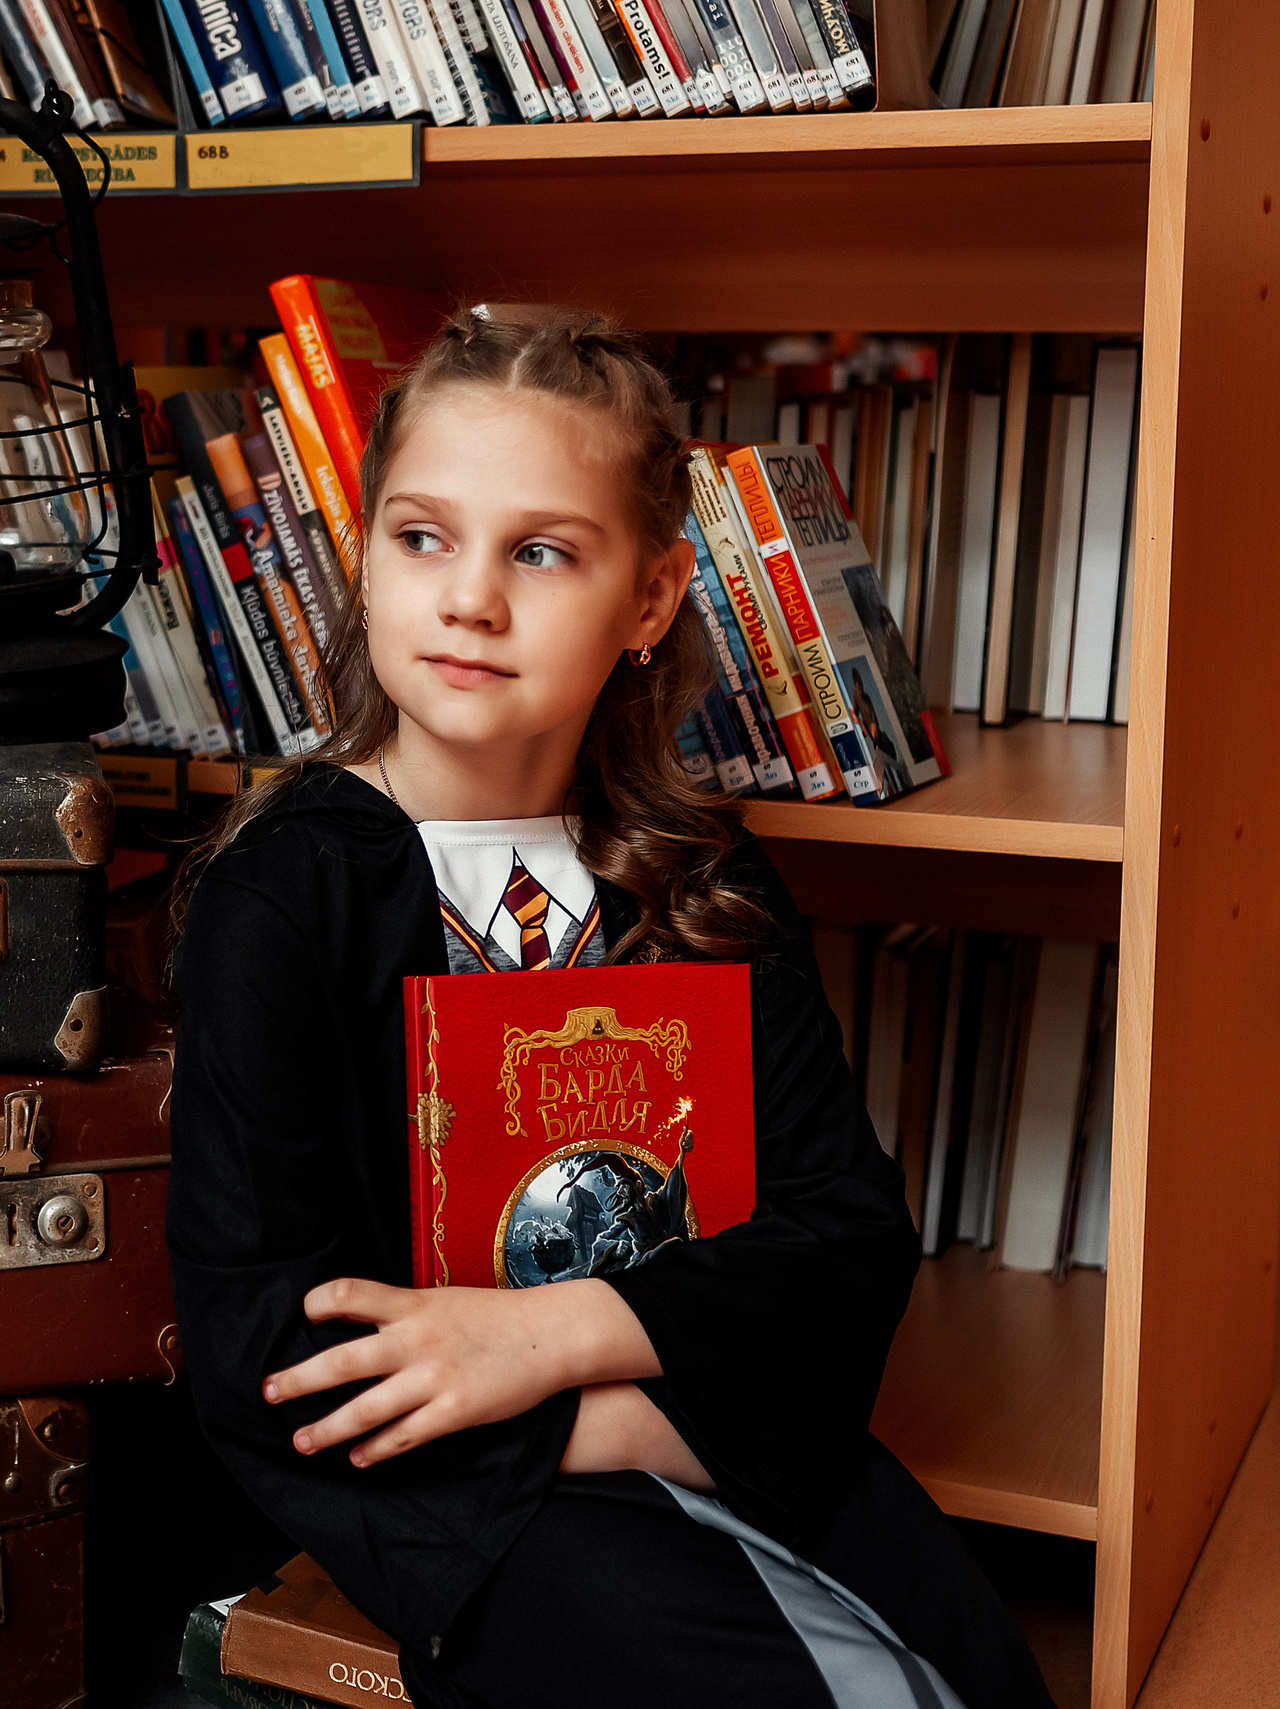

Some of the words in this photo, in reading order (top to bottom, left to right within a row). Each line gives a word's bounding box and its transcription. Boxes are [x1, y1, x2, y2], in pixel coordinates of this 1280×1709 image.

[626, 0, 671, 80] Protams!
[734, 460, 778, 545] ТЕПЛИЦЫ
[733, 553, 754, 592] РУКАМИ
[769, 552, 815, 641] ПАРНИКИ
[725, 571, 780, 680] РЕМОНТ
[801, 642, 843, 721] СТРОИМ
[535, 1097, 653, 1143] БИДЛЯ
[537, 1060, 648, 1106] БАРДА
